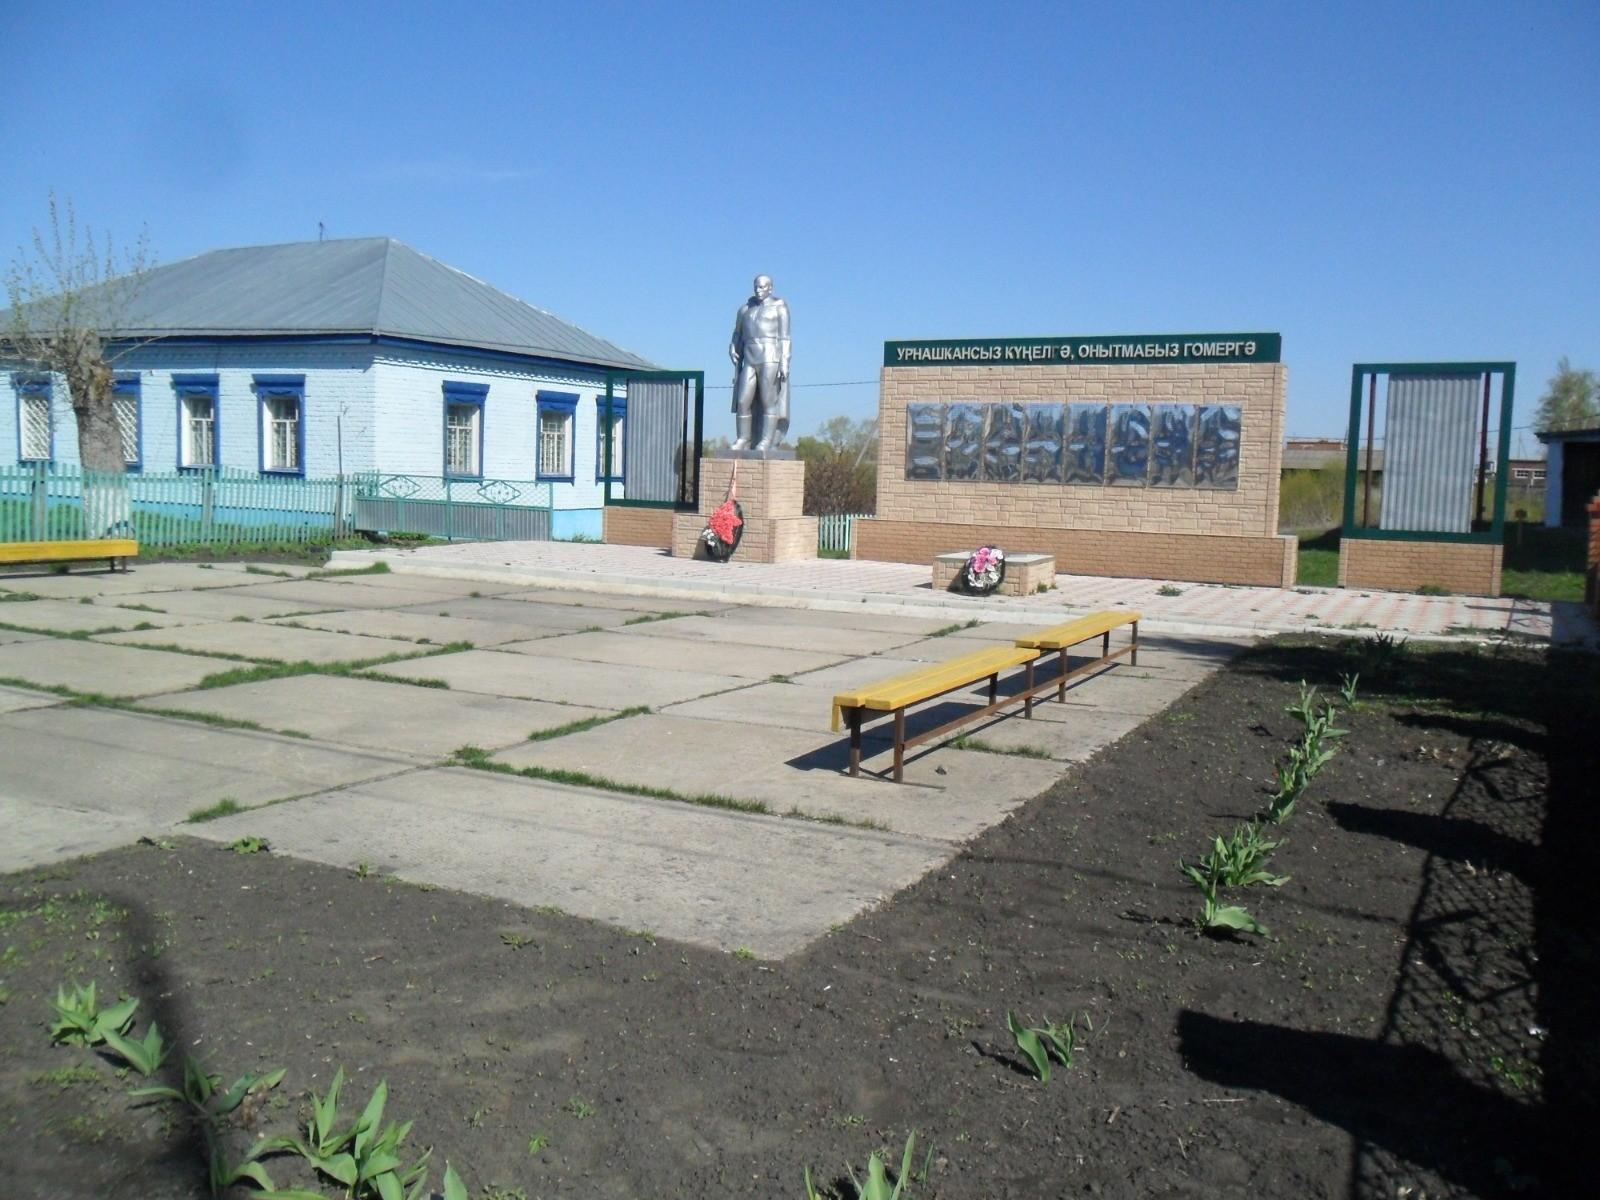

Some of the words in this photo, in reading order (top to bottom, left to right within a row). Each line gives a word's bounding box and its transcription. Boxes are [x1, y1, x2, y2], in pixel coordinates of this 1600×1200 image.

[897, 346, 1001, 361] УРНАШКАНСЫЗ
[1078, 342, 1180, 358] ОНЫТМАБЫЗ
[1183, 341, 1256, 356] ГОМЕРГӘ
